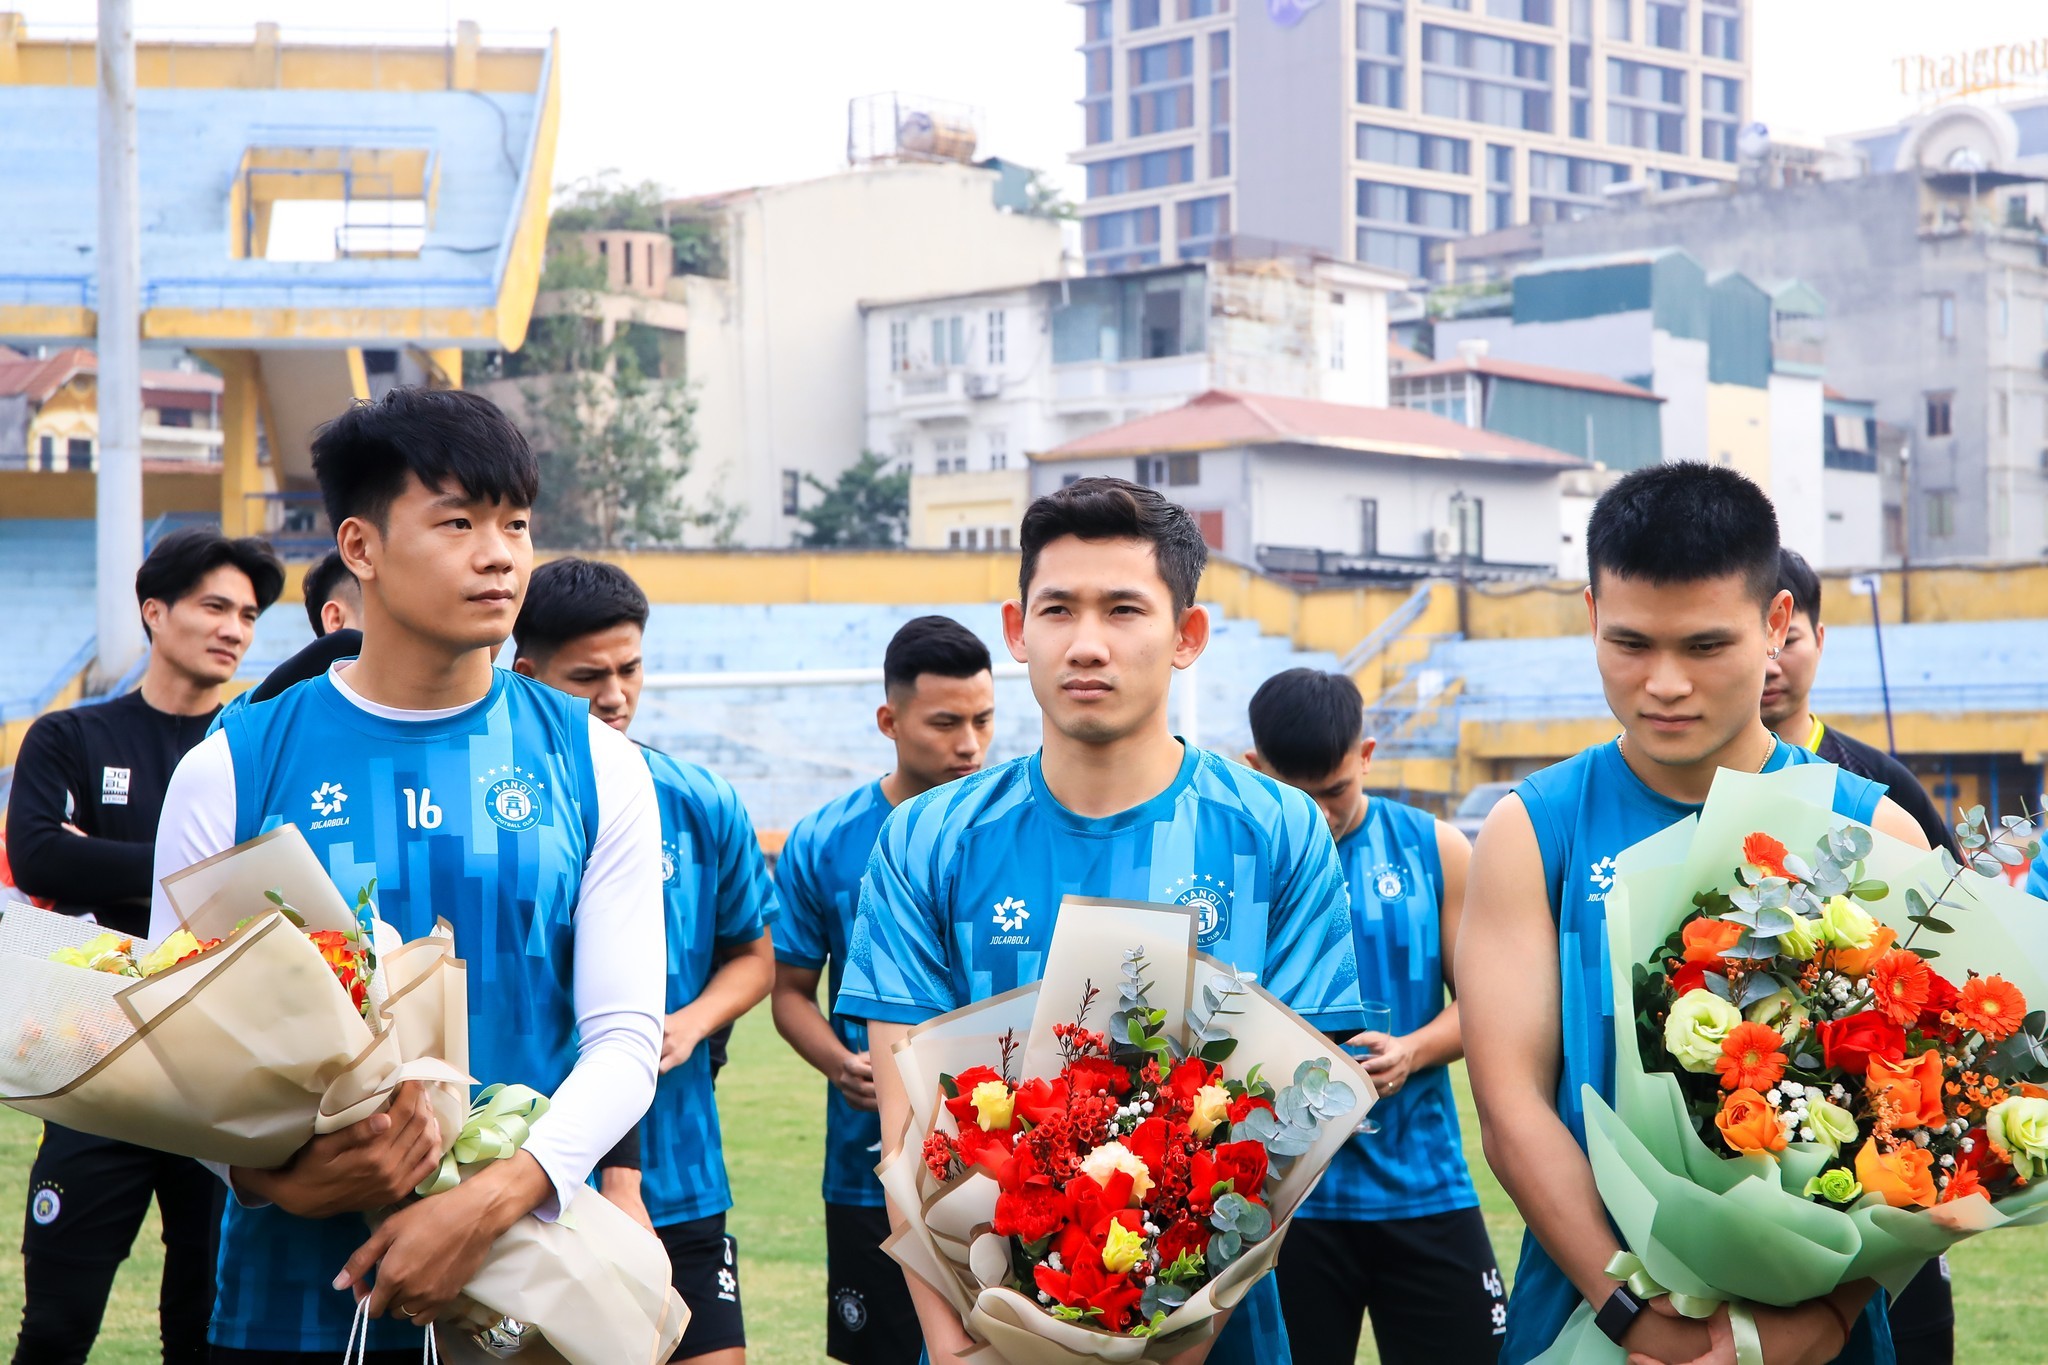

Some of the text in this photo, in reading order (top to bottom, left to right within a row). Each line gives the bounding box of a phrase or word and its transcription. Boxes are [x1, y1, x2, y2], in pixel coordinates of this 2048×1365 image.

[492, 780, 532, 796] HANOI
[403, 787, 443, 829] 16
[494, 814, 521, 828] FOOTBALL
[1179, 889, 1221, 906] HANOI
